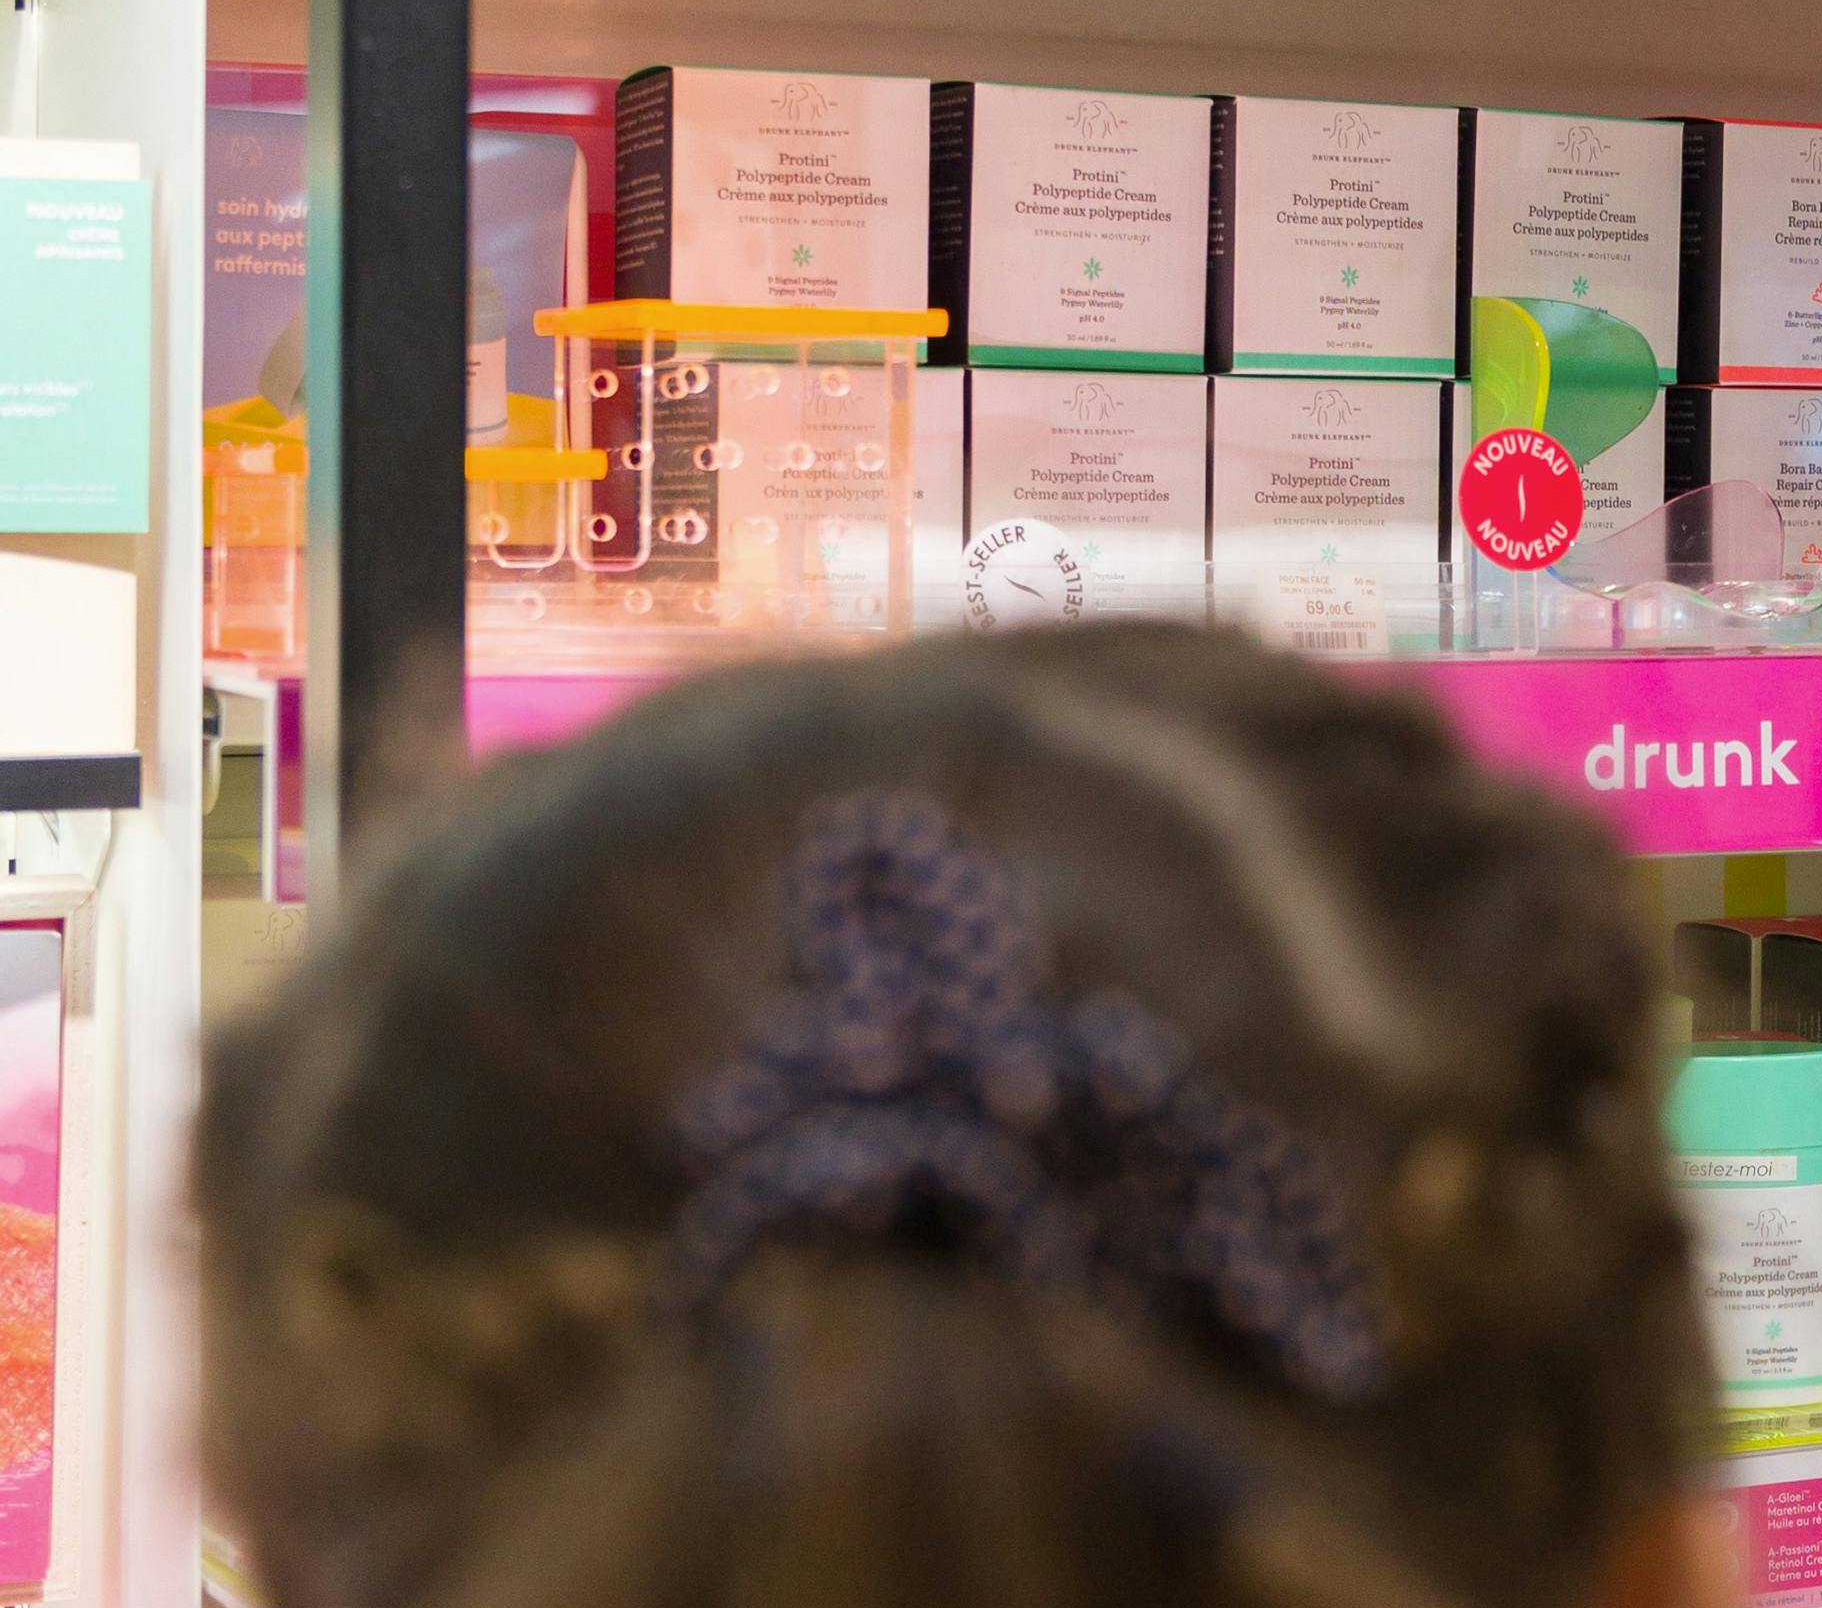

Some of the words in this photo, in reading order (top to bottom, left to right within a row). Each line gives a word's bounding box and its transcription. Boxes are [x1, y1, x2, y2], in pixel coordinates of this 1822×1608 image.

[736, 169, 822, 186] Polypeptide
[825, 172, 871, 187] Cream
[718, 188, 766, 202] Crème
[769, 193, 794, 203] aux
[797, 191, 889, 207] polypeptides
[1293, 194, 1367, 211] Polypeptide
[1369, 198, 1409, 213] Cream
[1792, 200, 1816, 212] Bora
[217, 197, 259, 217] soin
[1276, 210, 1319, 226] Crème
[1321, 214, 1344, 227] aux
[1346, 213, 1423, 231] polypeptides
[215, 229, 253, 244] aux
[1775, 233, 1812, 246] Crème
[214, 254, 306, 276] raffermis
[1473, 433, 1569, 478] NOUVEAU
[1478, 518, 1569, 562] NOUVEAU
[1584, 720, 1801, 791] drunk
[1683, 1161, 1776, 1177] Testez-moi
[1768, 1502, 1815, 1517] Maretinol
[1768, 1518, 1793, 1530] Huile
[1769, 1556, 1803, 1571] Retinol
